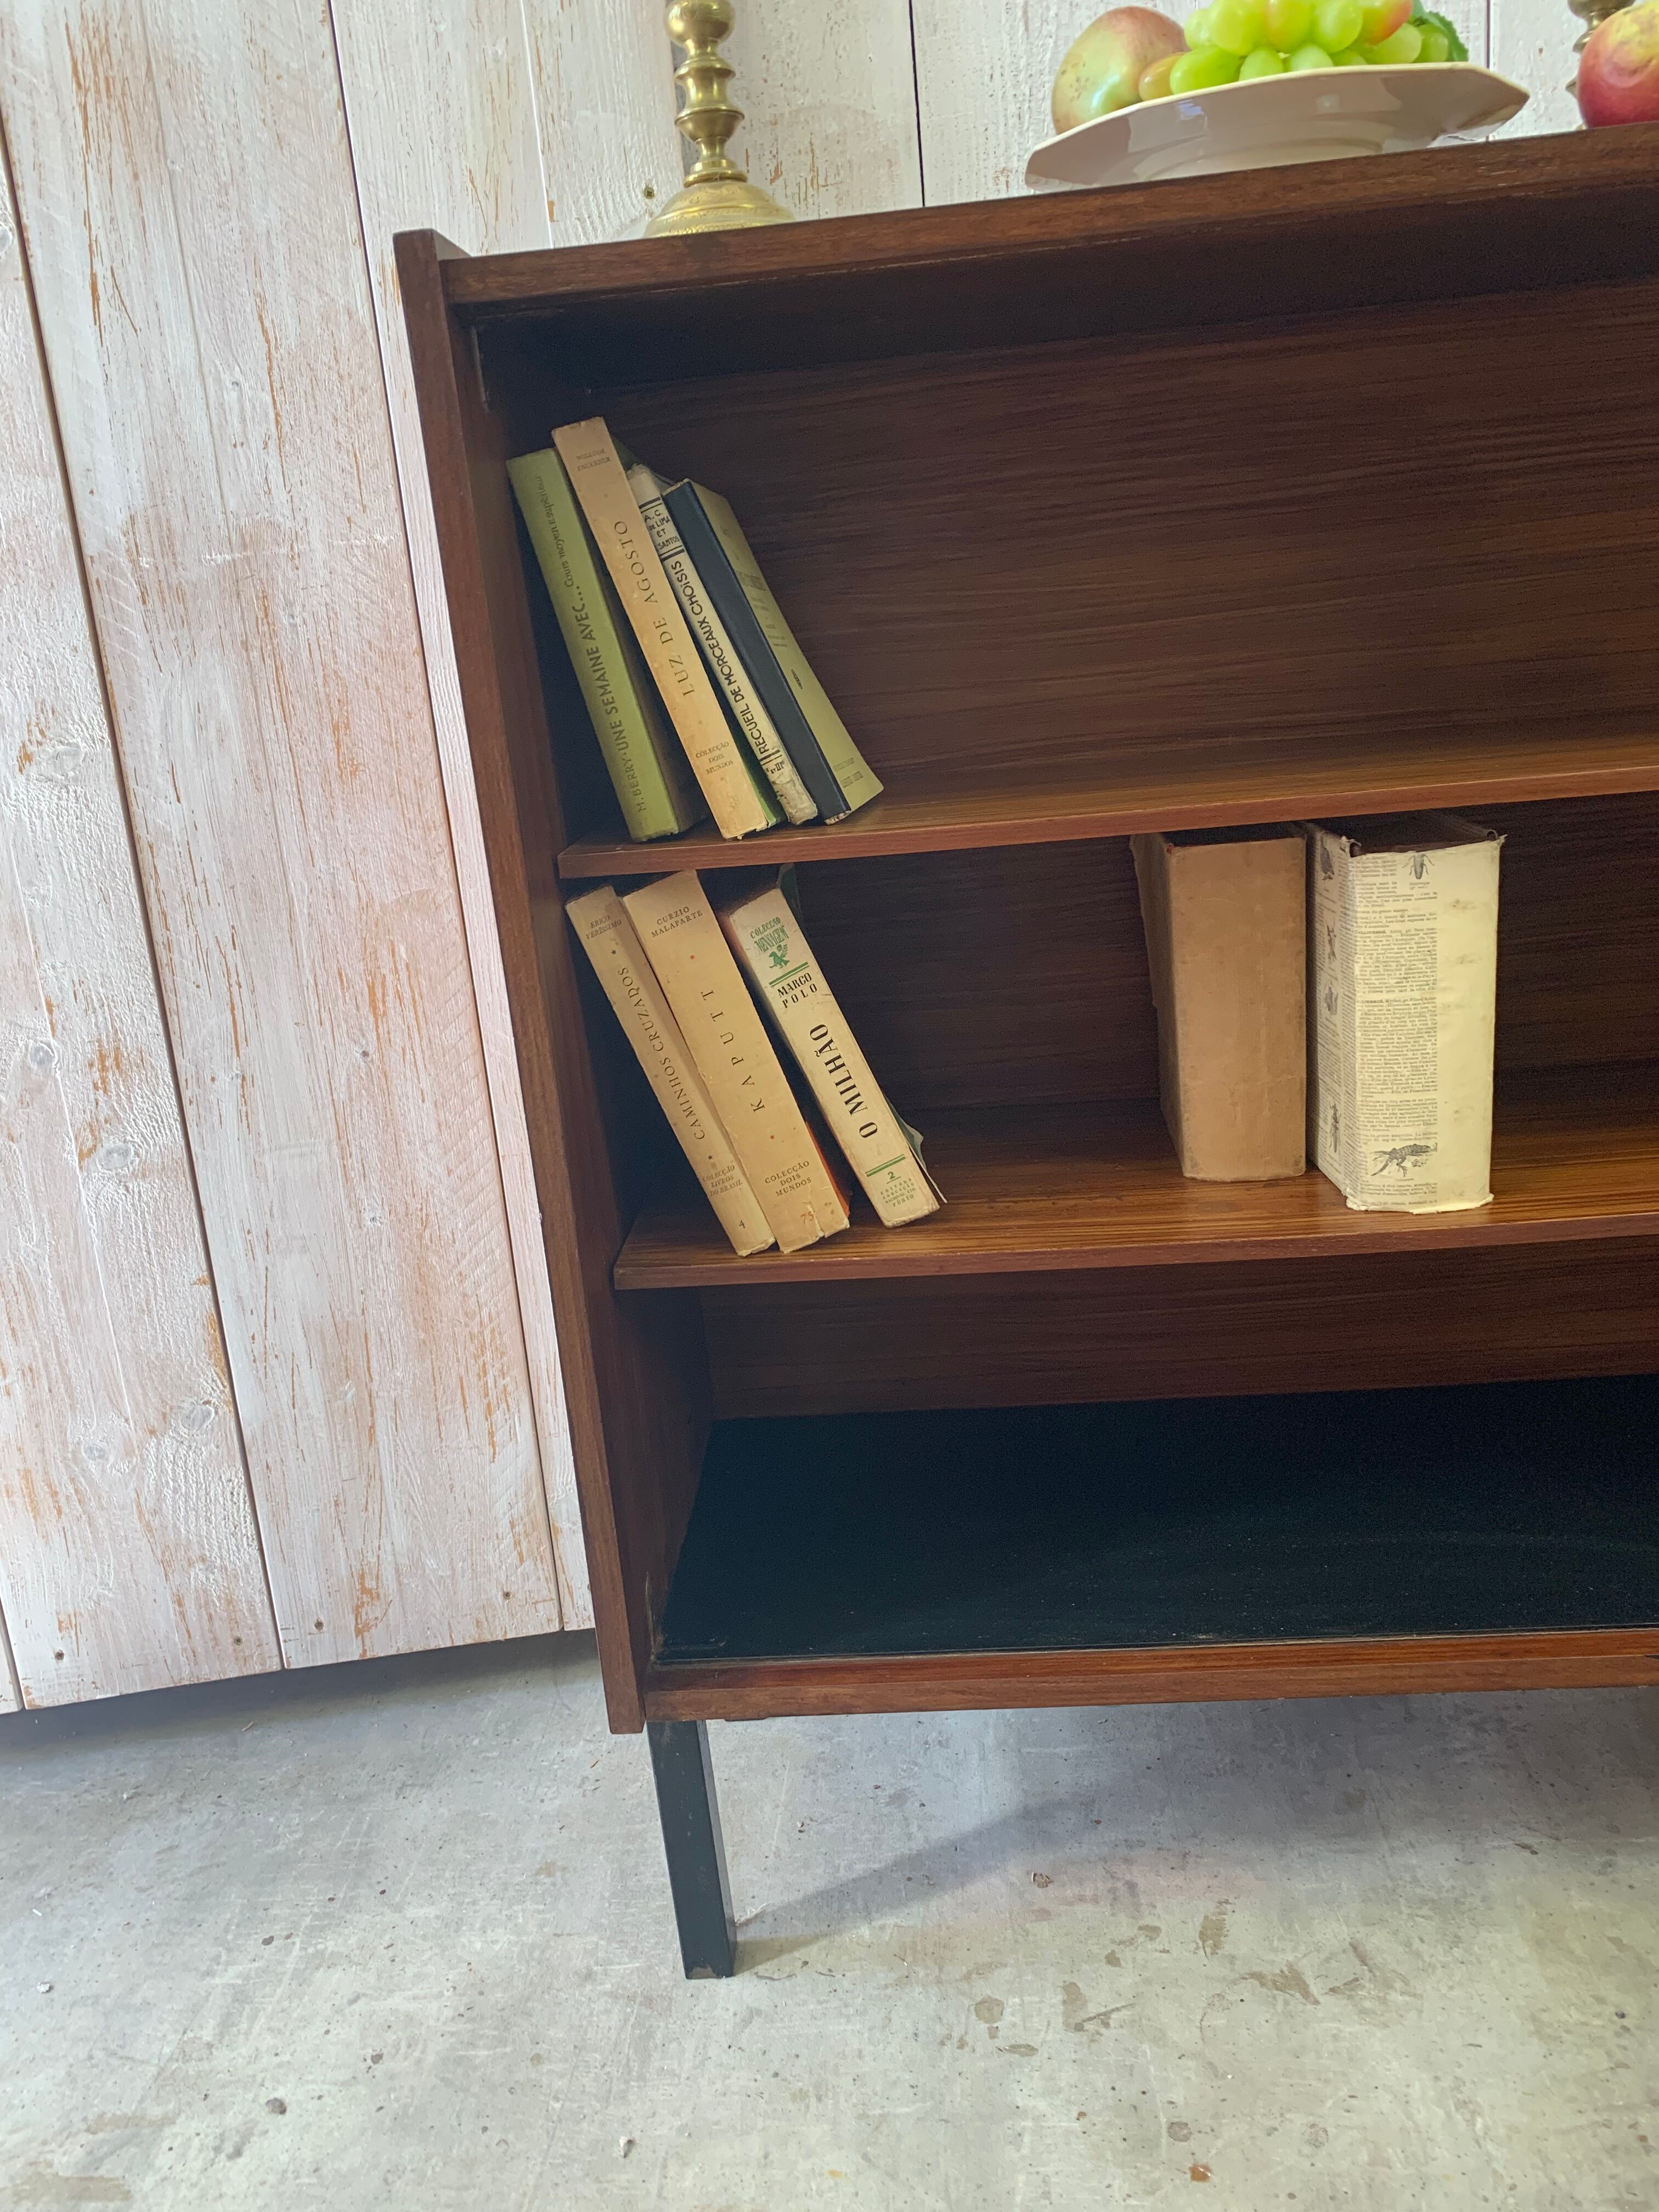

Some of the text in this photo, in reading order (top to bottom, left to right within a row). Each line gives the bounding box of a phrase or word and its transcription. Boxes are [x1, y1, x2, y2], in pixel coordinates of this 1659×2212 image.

[655, 516, 670, 527] LIMA
[656, 528, 666, 538] ET
[658, 535, 680, 550] SANTOS
[561, 558, 574, 588] Cours
[614, 521, 695, 696] LUZ DE AGOSTO
[697, 616, 737, 686] MORCEAUX
[586, 646, 619, 715] SEMAINE
[730, 685, 744, 703] DE
[610, 719, 629, 752] UNE
[740, 703, 770, 754] RECUEIL
[706, 759, 733, 775] MUNDOS
[708, 753, 724, 764] DOIS
[590, 915, 610, 928] ERICO
[651, 910, 703, 938] MALAPARTE
[657, 906, 689, 925] CURZIO
[777, 972, 812, 998] MARCO
[782, 983, 817, 1009] POLO
[618, 967, 706, 1140] CAMINHOS CRUZADOS
[701, 988, 765, 1113] KAPUTT
[809, 1023, 878, 1138] O MILHÃO
[711, 1174, 733, 1188] LIVROS
[780, 1173, 801, 1186] DOIS
[887, 1171, 896, 1180] 2
[720, 1179, 743, 1193] BRASIL
[775, 1177, 812, 1197] MUNDOS
[738, 1220, 746, 1229] 4
[800, 1211, 814, 1224] 75
